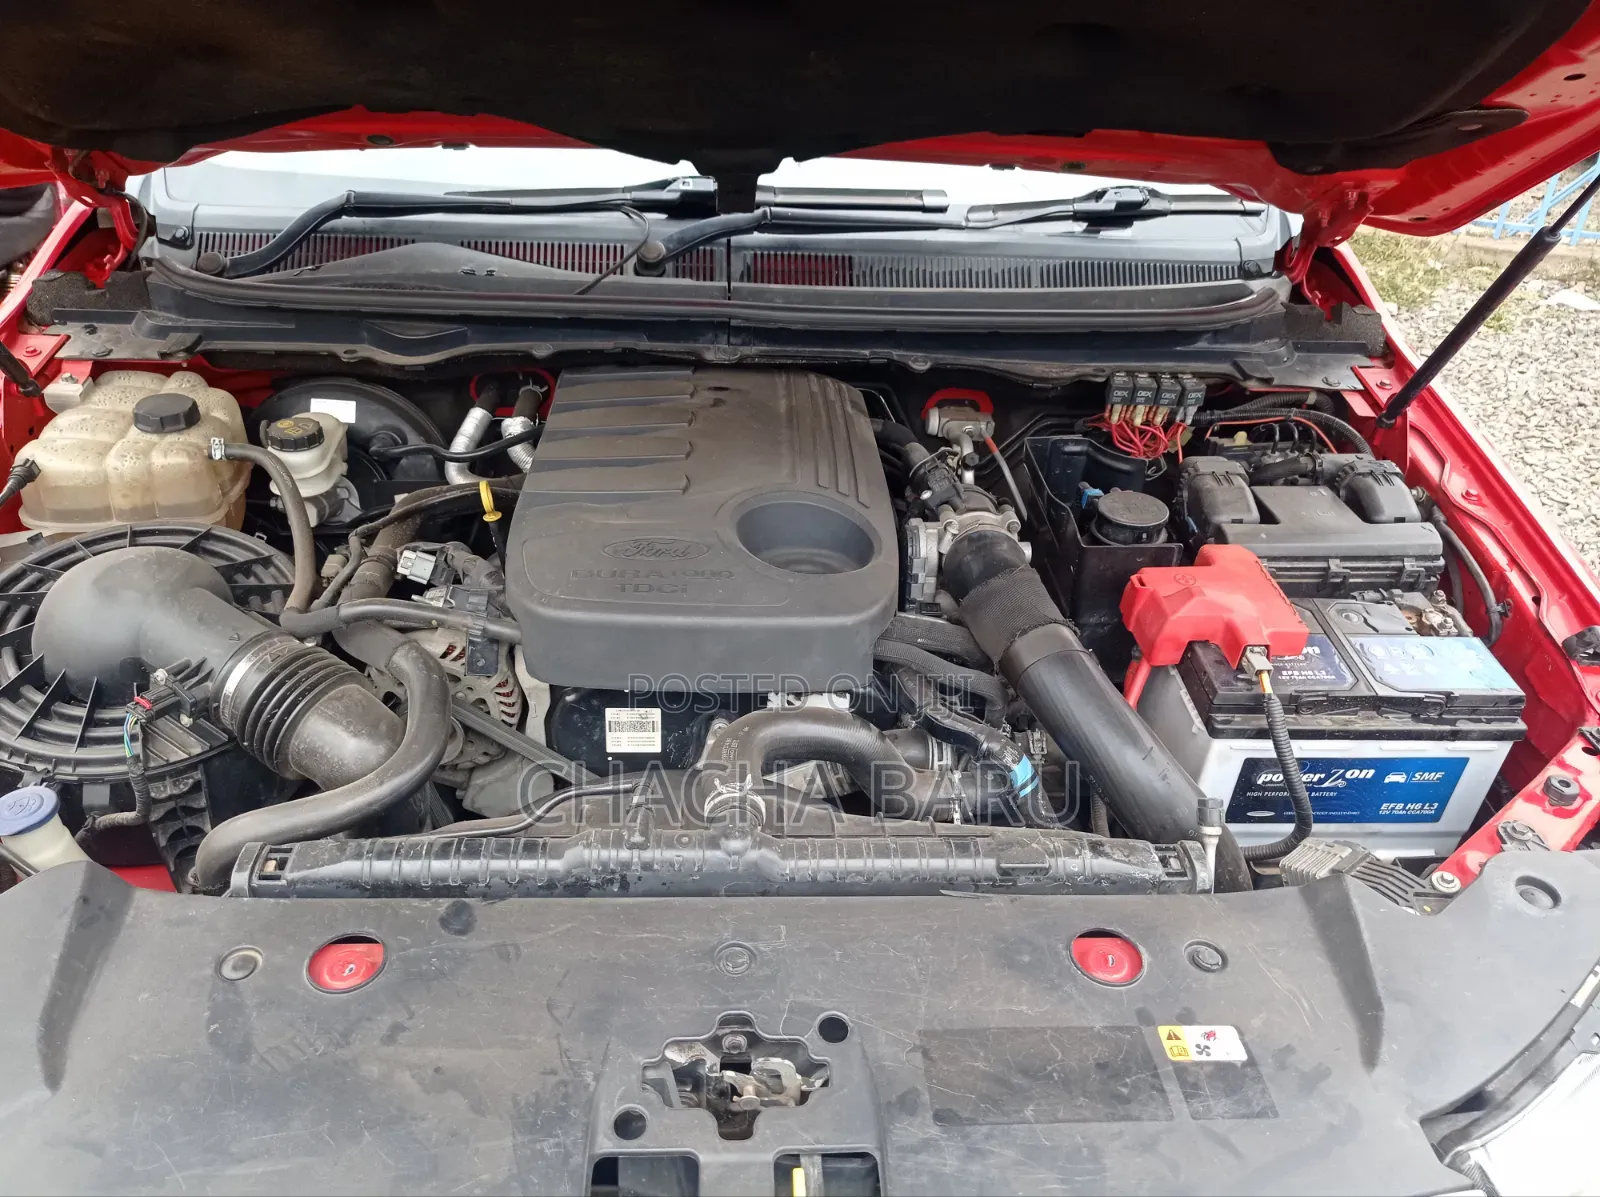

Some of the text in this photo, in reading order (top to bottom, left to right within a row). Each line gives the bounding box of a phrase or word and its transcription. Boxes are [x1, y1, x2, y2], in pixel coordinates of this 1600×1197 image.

[1137, 390, 1153, 398] OEX
[621, 541, 692, 558] Ford
[616, 583, 689, 594] TDCi
[1411, 771, 1445, 781] SMF
[1380, 802, 1404, 810] EFB
[1422, 802, 1439, 810] L3
